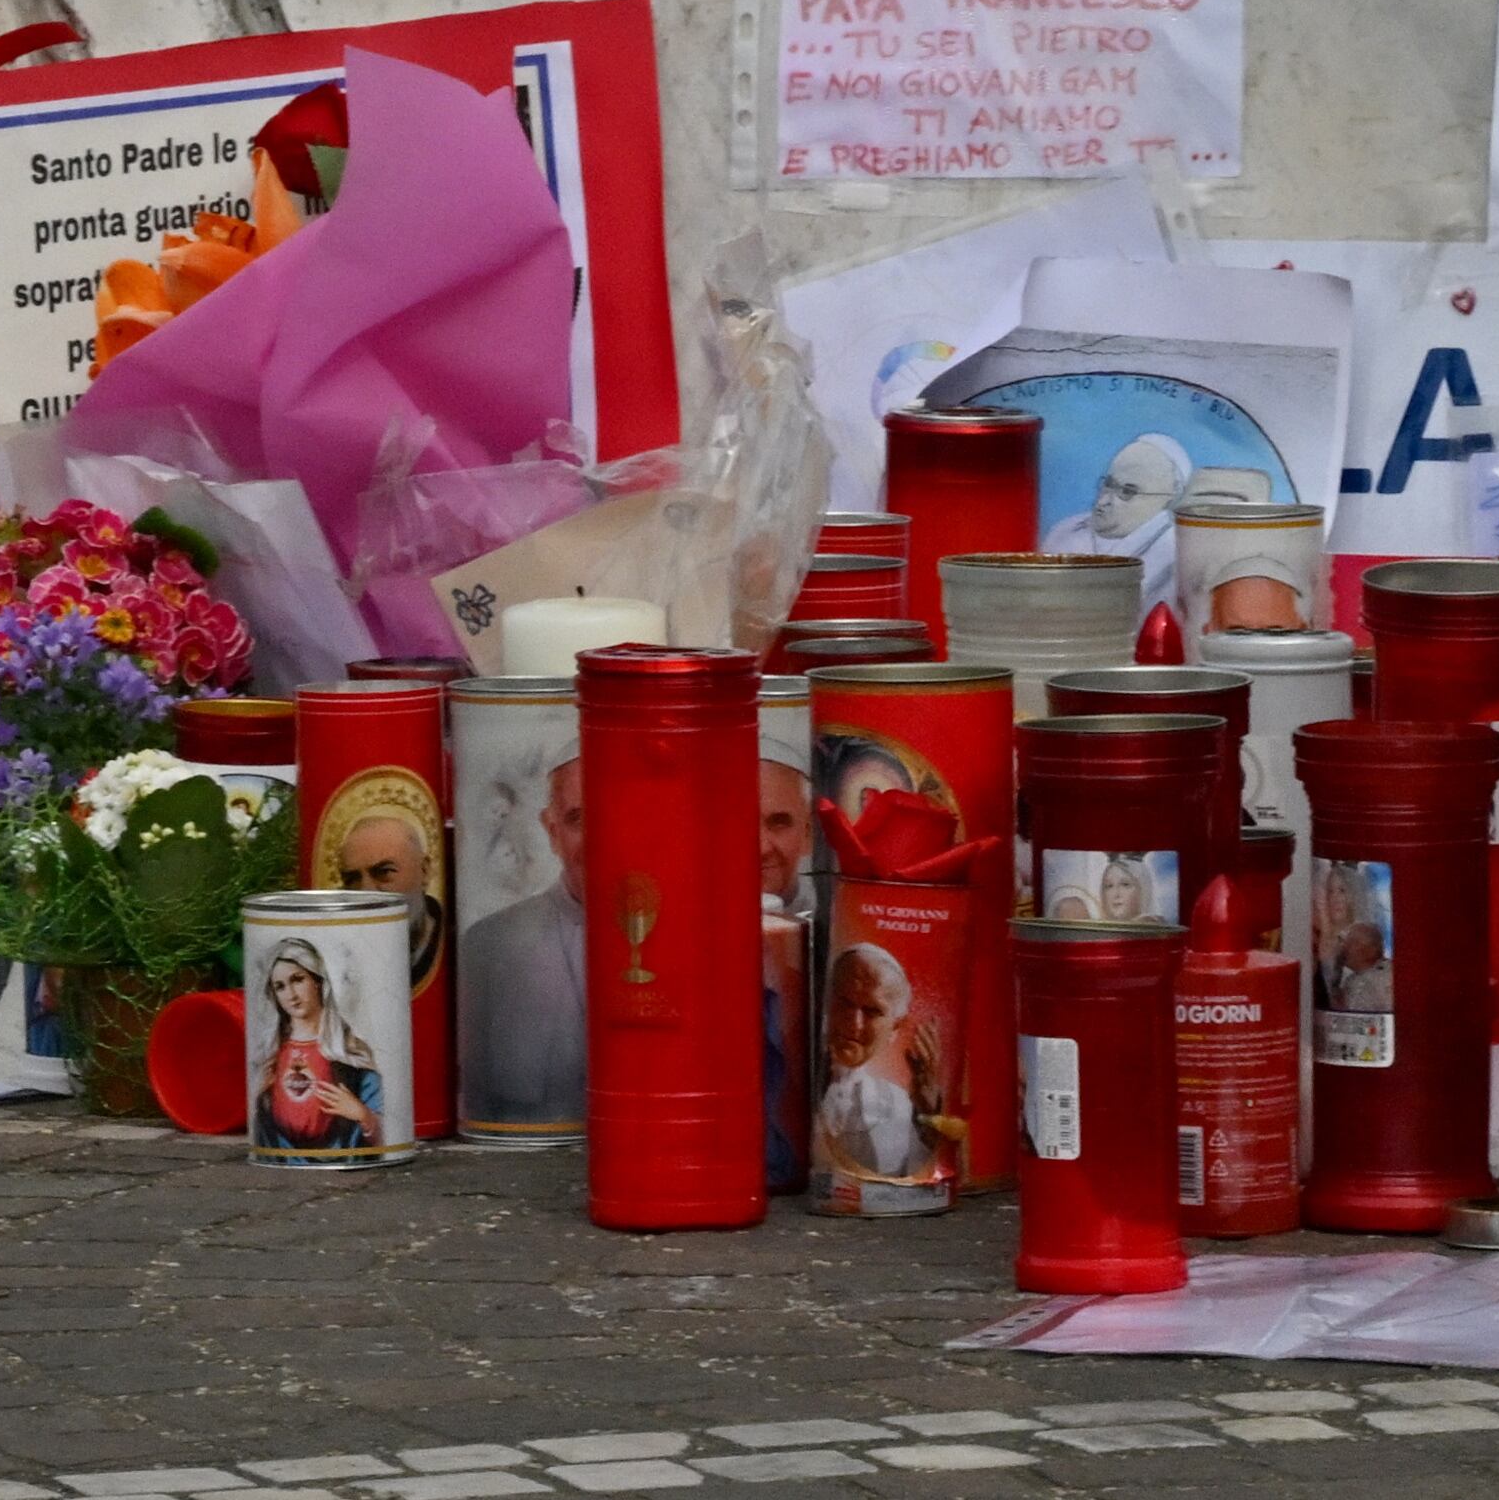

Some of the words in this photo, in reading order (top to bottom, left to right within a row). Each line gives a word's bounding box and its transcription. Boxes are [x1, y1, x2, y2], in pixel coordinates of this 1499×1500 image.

[915, 30, 977, 59] SEI
[1011, 25, 1152, 54] PIETRO
[783, 72, 813, 103] E
[825, 75, 882, 100] NOI
[901, 68, 1048, 98] GIOVANI
[1061, 66, 1137, 95] GAM
[905, 108, 949, 135] TI
[968, 106, 1120, 134] AMIAMO
[30, 147, 112, 185] Santo
[122, 137, 202, 175] Padre
[213, 132, 238, 165] le
[781, 147, 808, 175] E
[830, 145, 1012, 175] PREGHIAMO
[1042, 140, 1108, 168] PER
[35, 205, 126, 253] pronta
[1134, 377, 1177, 399] TINGE
[1188, 1004, 1261, 1024] GIORNI
